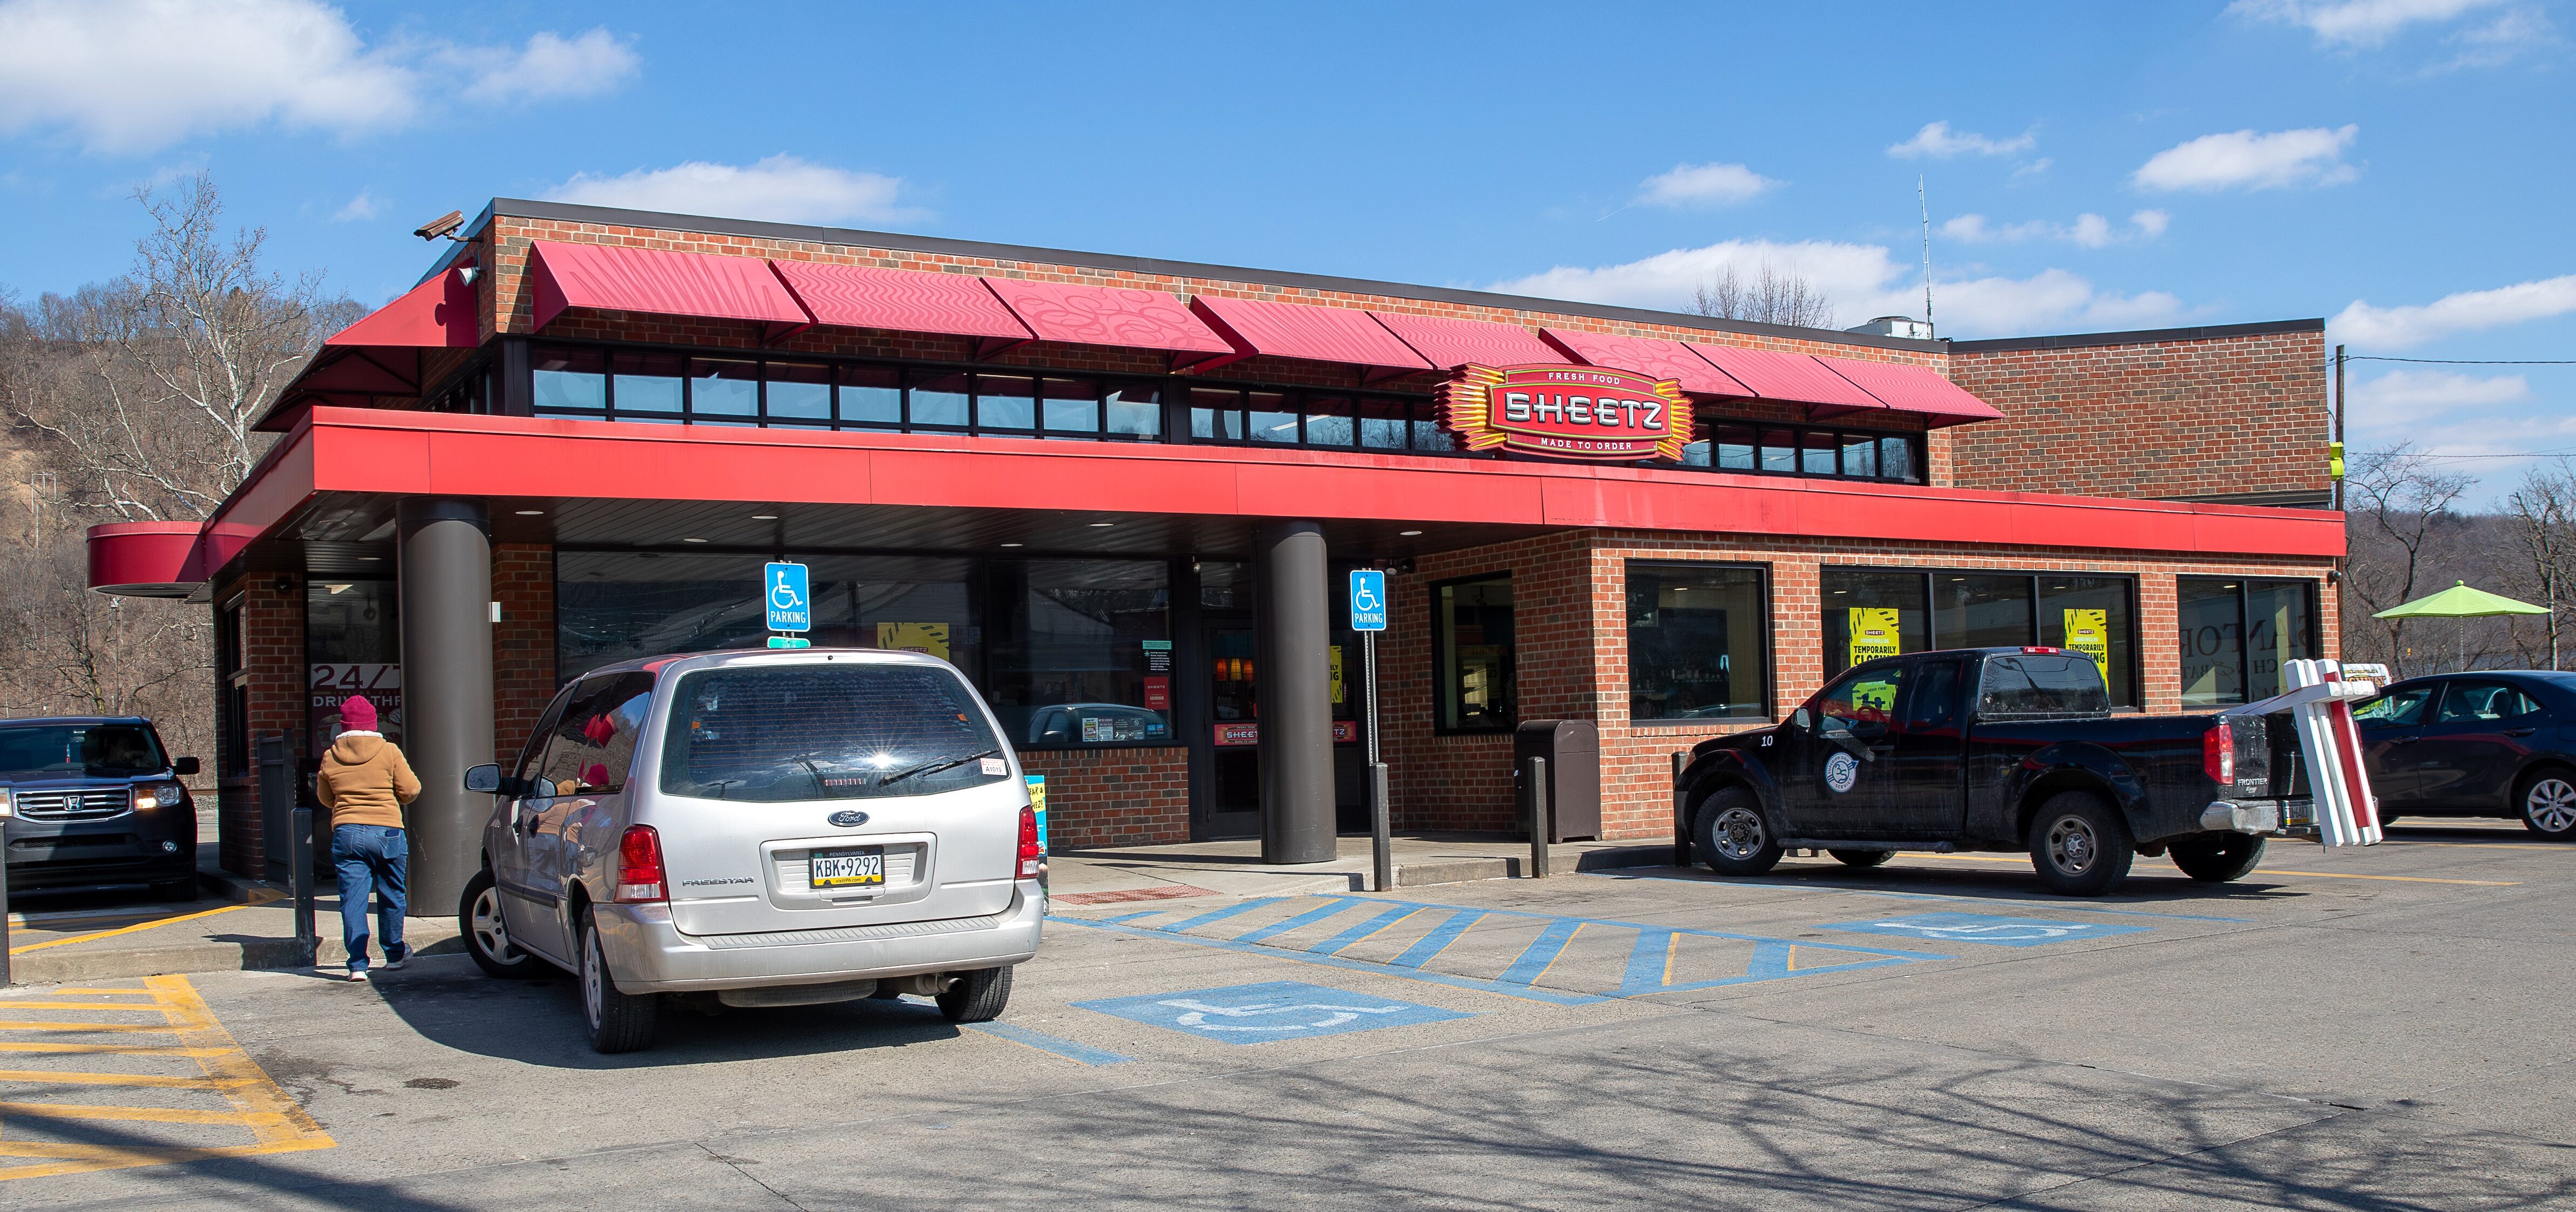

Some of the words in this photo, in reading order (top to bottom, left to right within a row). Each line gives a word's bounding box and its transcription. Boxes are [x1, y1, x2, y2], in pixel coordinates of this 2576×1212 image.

[1548, 372, 1585, 381] FRESH
[1593, 375, 1621, 384] FOOD
[1505, 392, 1663, 430] SHEETZ
[1541, 438, 1571, 448] MADE
[1578, 441, 1591, 449] TO
[1597, 442, 1632, 450] ORDER
[770, 611, 806, 624] PARKING
[1354, 613, 1383, 623] PARKING
[1761, 735, 1773, 747] 10
[1828, 756, 1840, 774] SUPERIOR
[1835, 777, 1852, 788] SERVICE
[2237, 778, 2268, 786] FRONTIER
[838, 811, 861, 822] Ford
[682, 876, 755, 886] FREESTAR
